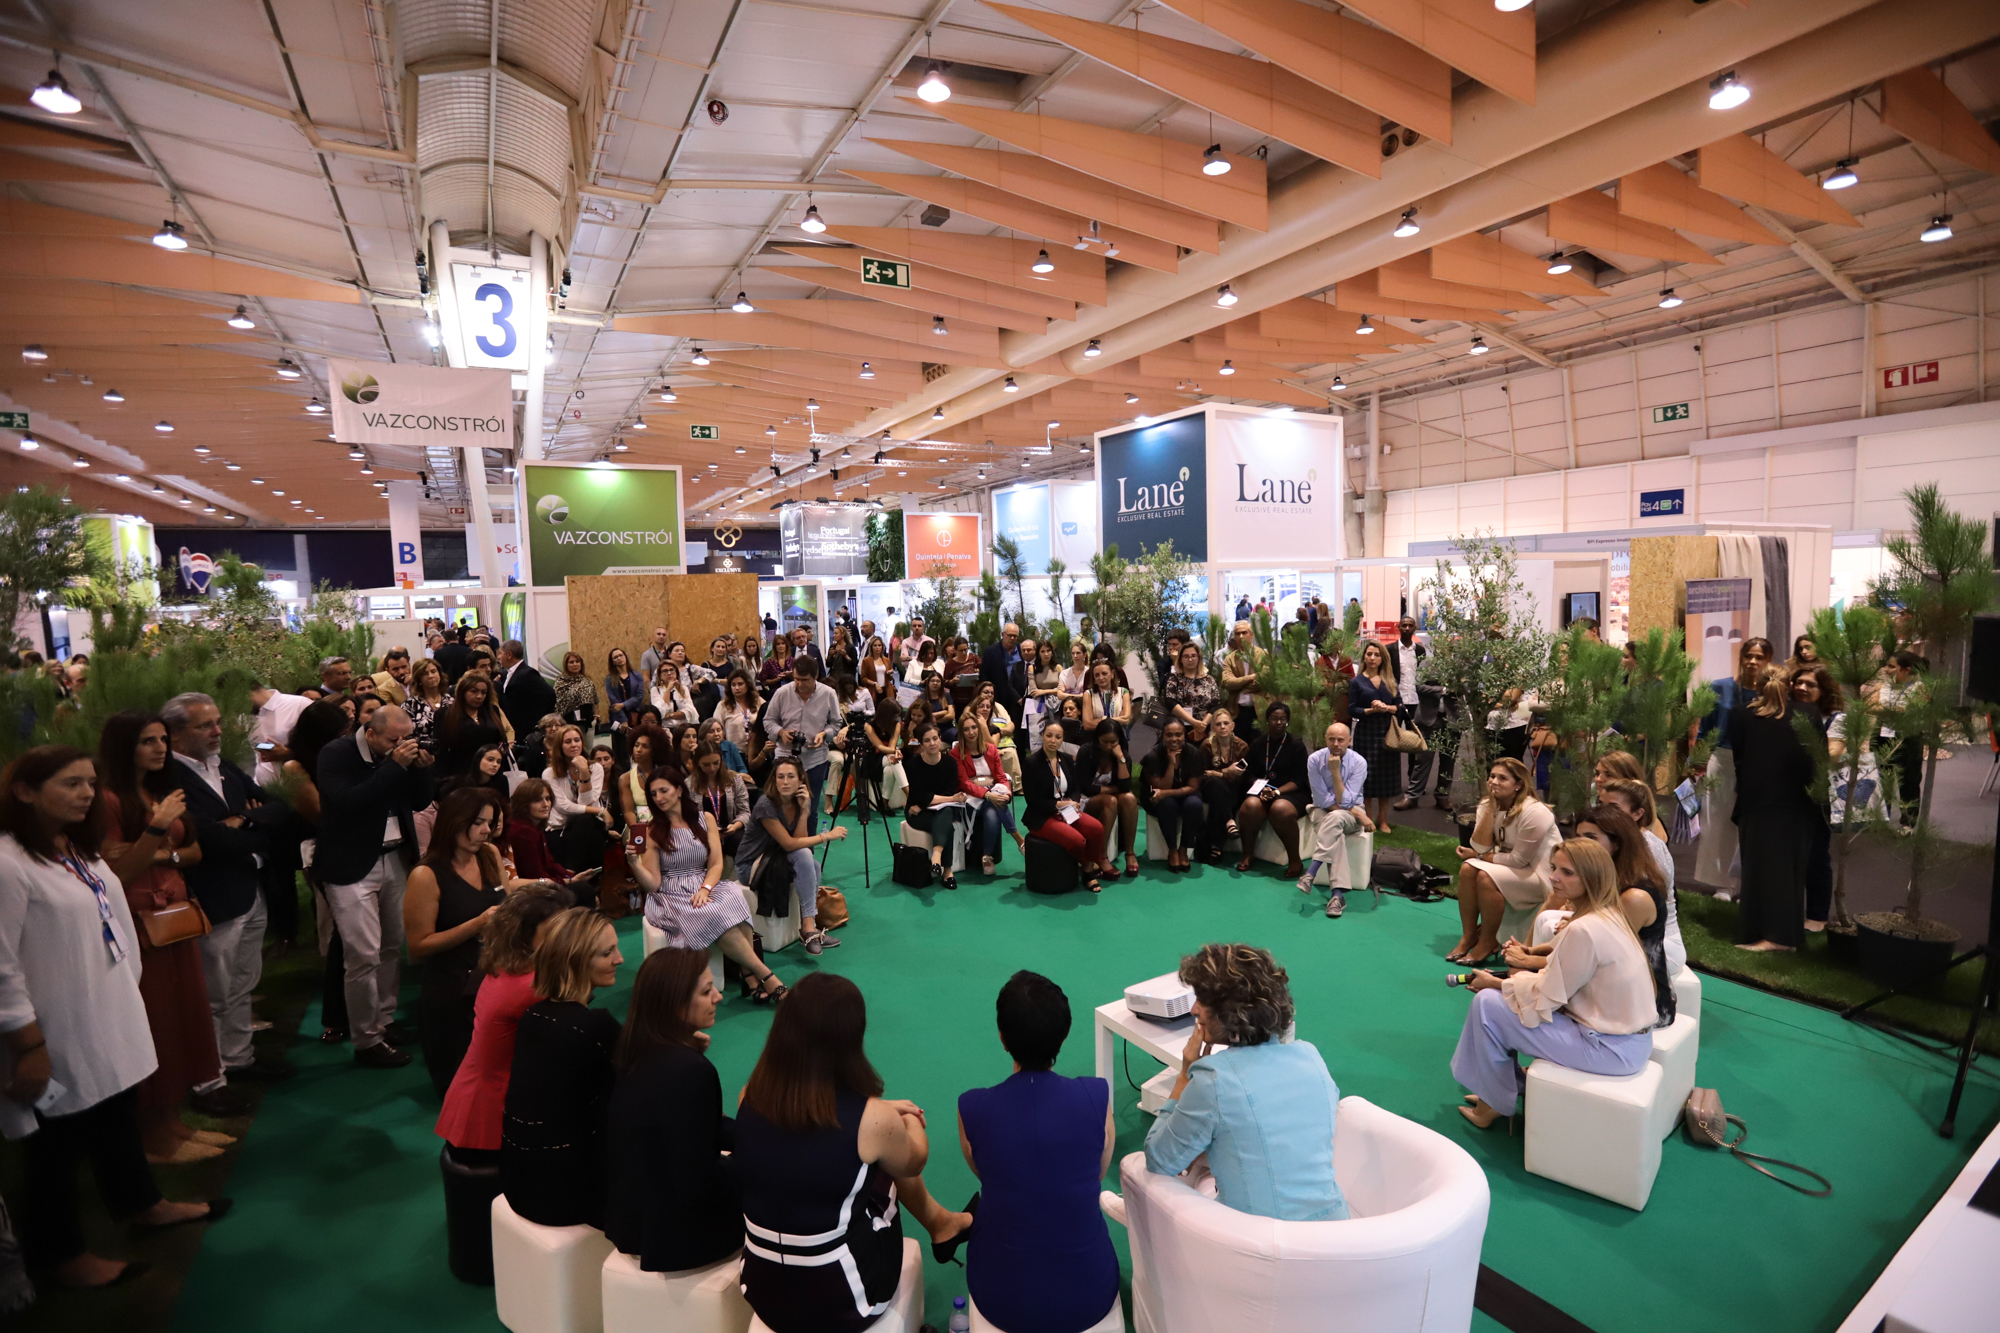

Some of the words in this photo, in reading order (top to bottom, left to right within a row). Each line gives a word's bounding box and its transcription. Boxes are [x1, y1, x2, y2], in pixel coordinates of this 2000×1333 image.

[474, 283, 517, 358] 3
[362, 412, 506, 433] VAZCONSTRÓI
[1235, 506, 1271, 514] EXCLUSIVE
[1290, 507, 1313, 515] ESTATE
[1652, 501, 1660, 511] 4
[1117, 513, 1146, 523] EXCLUSIVE
[1147, 511, 1162, 519] REAL
[1163, 508, 1185, 518] ESTATE
[553, 529, 673, 545] VAZCONSTRÓI
[398, 542, 417, 564] B
[946, 552, 972, 560] Penalva
